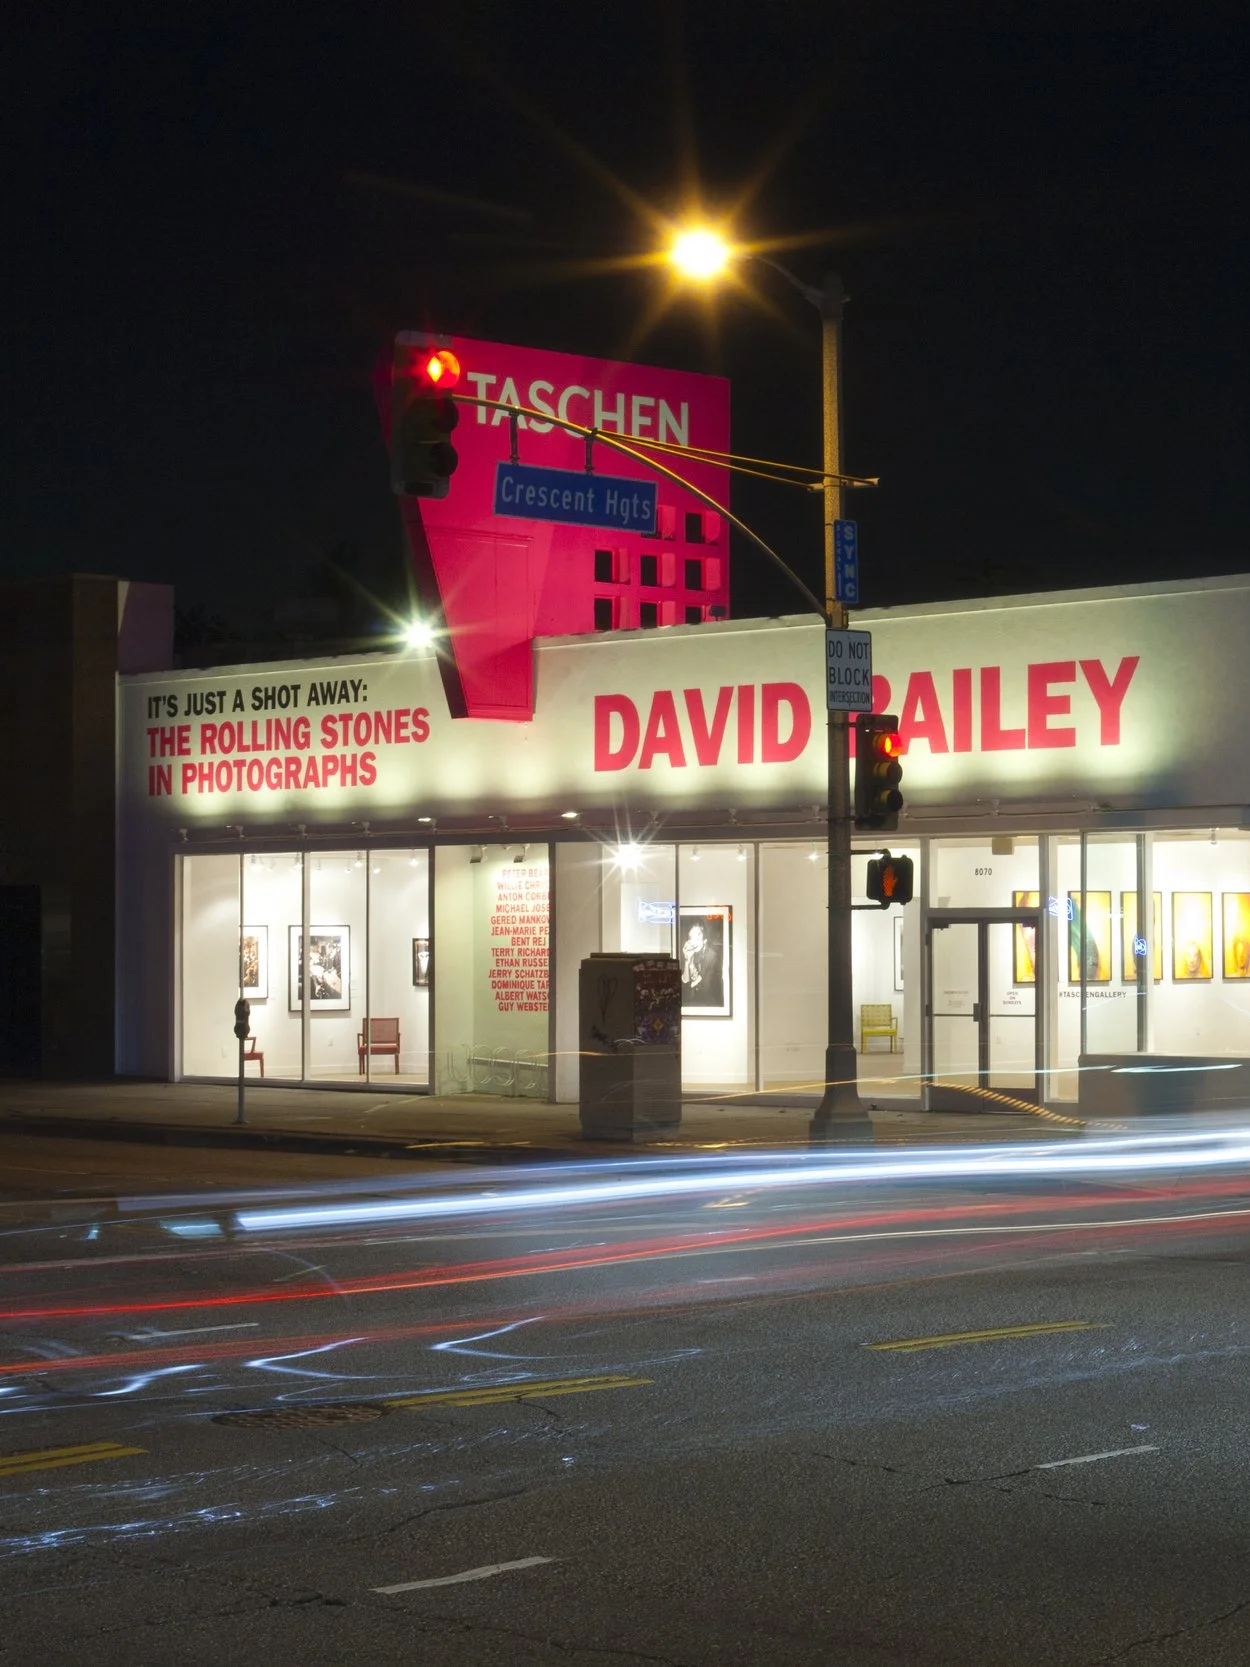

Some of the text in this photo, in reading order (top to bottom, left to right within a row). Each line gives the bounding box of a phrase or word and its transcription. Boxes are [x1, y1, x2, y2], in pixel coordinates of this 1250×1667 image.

[467, 372, 689, 447] TASCHEN
[502, 476, 651, 525] Crescent Hgts
[843, 526, 856, 597] SYNC
[829, 641, 869, 659] DO NOT
[829, 667, 869, 686] BLOCK
[148, 679, 368, 719] IT'S JUST A SHOT AWAY:
[830, 691, 870, 704] INTERSECTION
[594, 682, 812, 772] DAVID
[147, 707, 430, 757] THE ROLLING STONES
[149, 751, 377, 796] IN PHOTOGRAPHS
[975, 868, 992, 876] 8070
[498, 892, 522, 901] ANTON
[496, 904, 529, 913] MICHAEL
[491, 916, 516, 924] GERED
[491, 927, 536, 936] JEAN-MARIE
[511, 937, 530, 946] BENT
[492, 948, 514, 957] TERRY
[496, 959, 520, 967] ETHAN
[489, 970, 511, 978] JERRY
[491, 981, 535, 989] DOMINIQUE
[495, 992, 524, 1001] ALBERT
[499, 1002, 514, 1011] GUY
